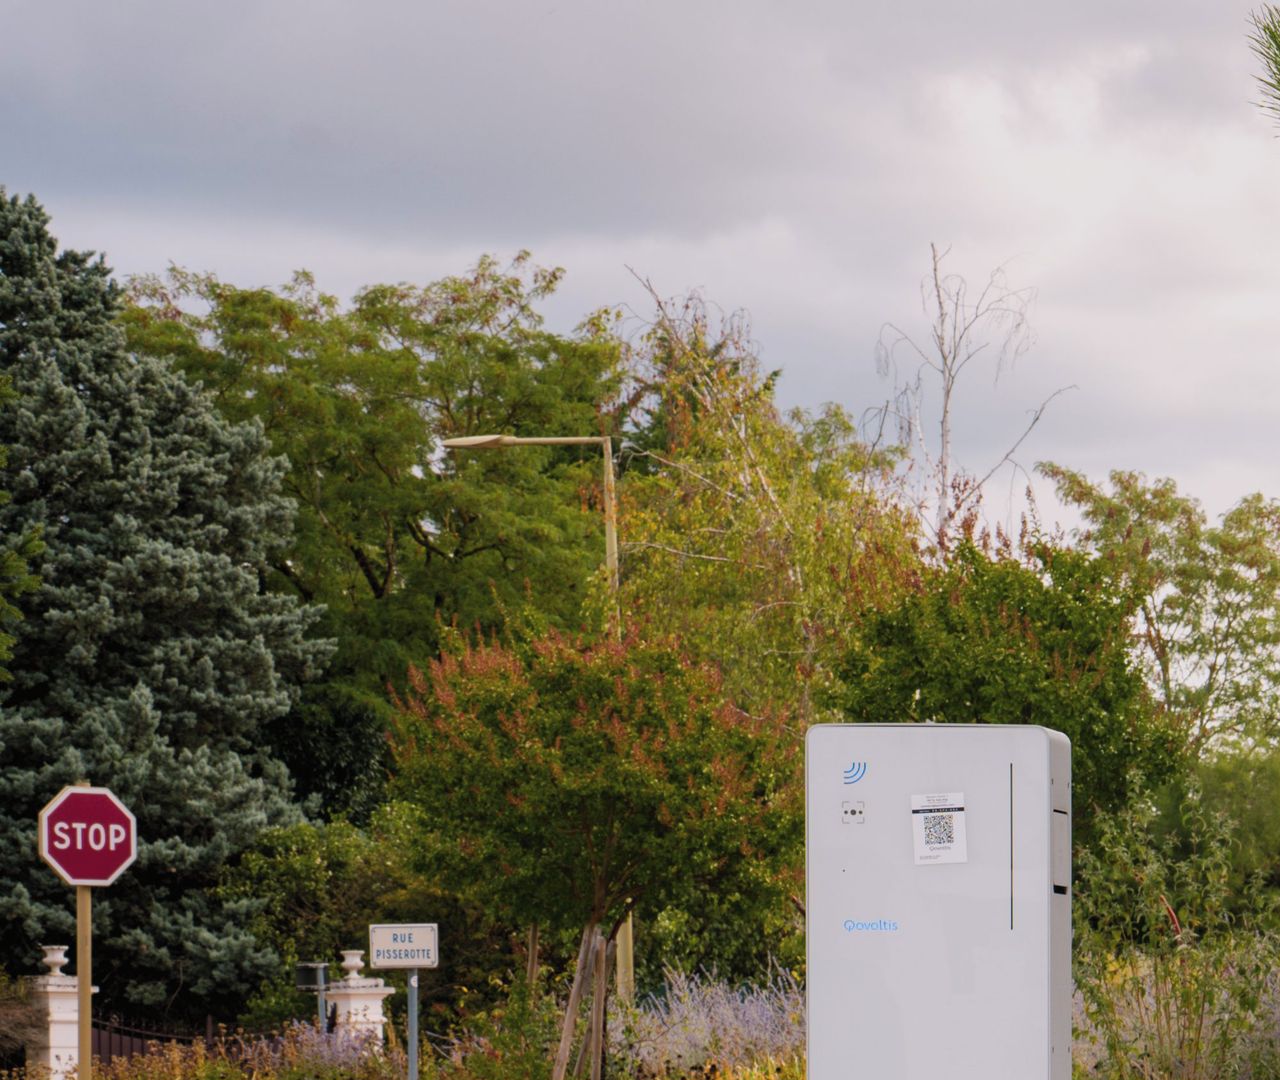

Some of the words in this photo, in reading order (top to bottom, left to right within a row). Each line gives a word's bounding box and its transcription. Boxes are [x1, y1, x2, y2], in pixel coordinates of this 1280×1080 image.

[53, 821, 126, 851] STOP
[843, 919, 898, 932] Qovoltis
[392, 933, 413, 943] RUE
[376, 949, 431, 959] PISSEROTTE
